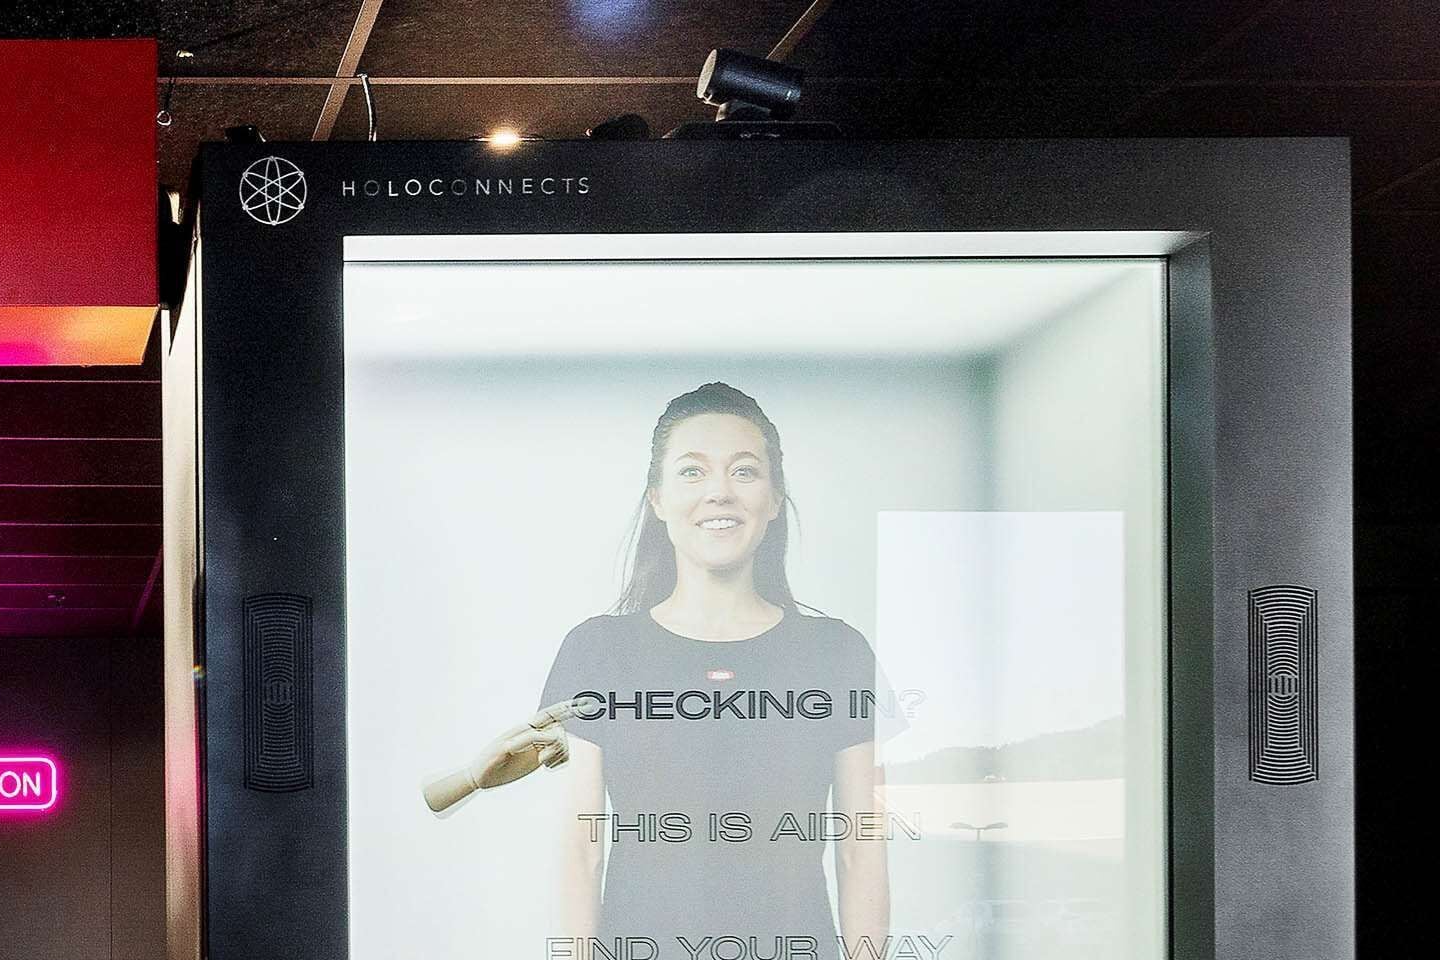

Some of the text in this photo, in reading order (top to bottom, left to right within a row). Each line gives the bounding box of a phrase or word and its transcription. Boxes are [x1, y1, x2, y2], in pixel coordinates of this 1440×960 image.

[341, 176, 591, 198] HOLOCONNECTS
[569, 689, 927, 721] CHECKING IN?
[578, 811, 922, 843] THIS IS AIDEN
